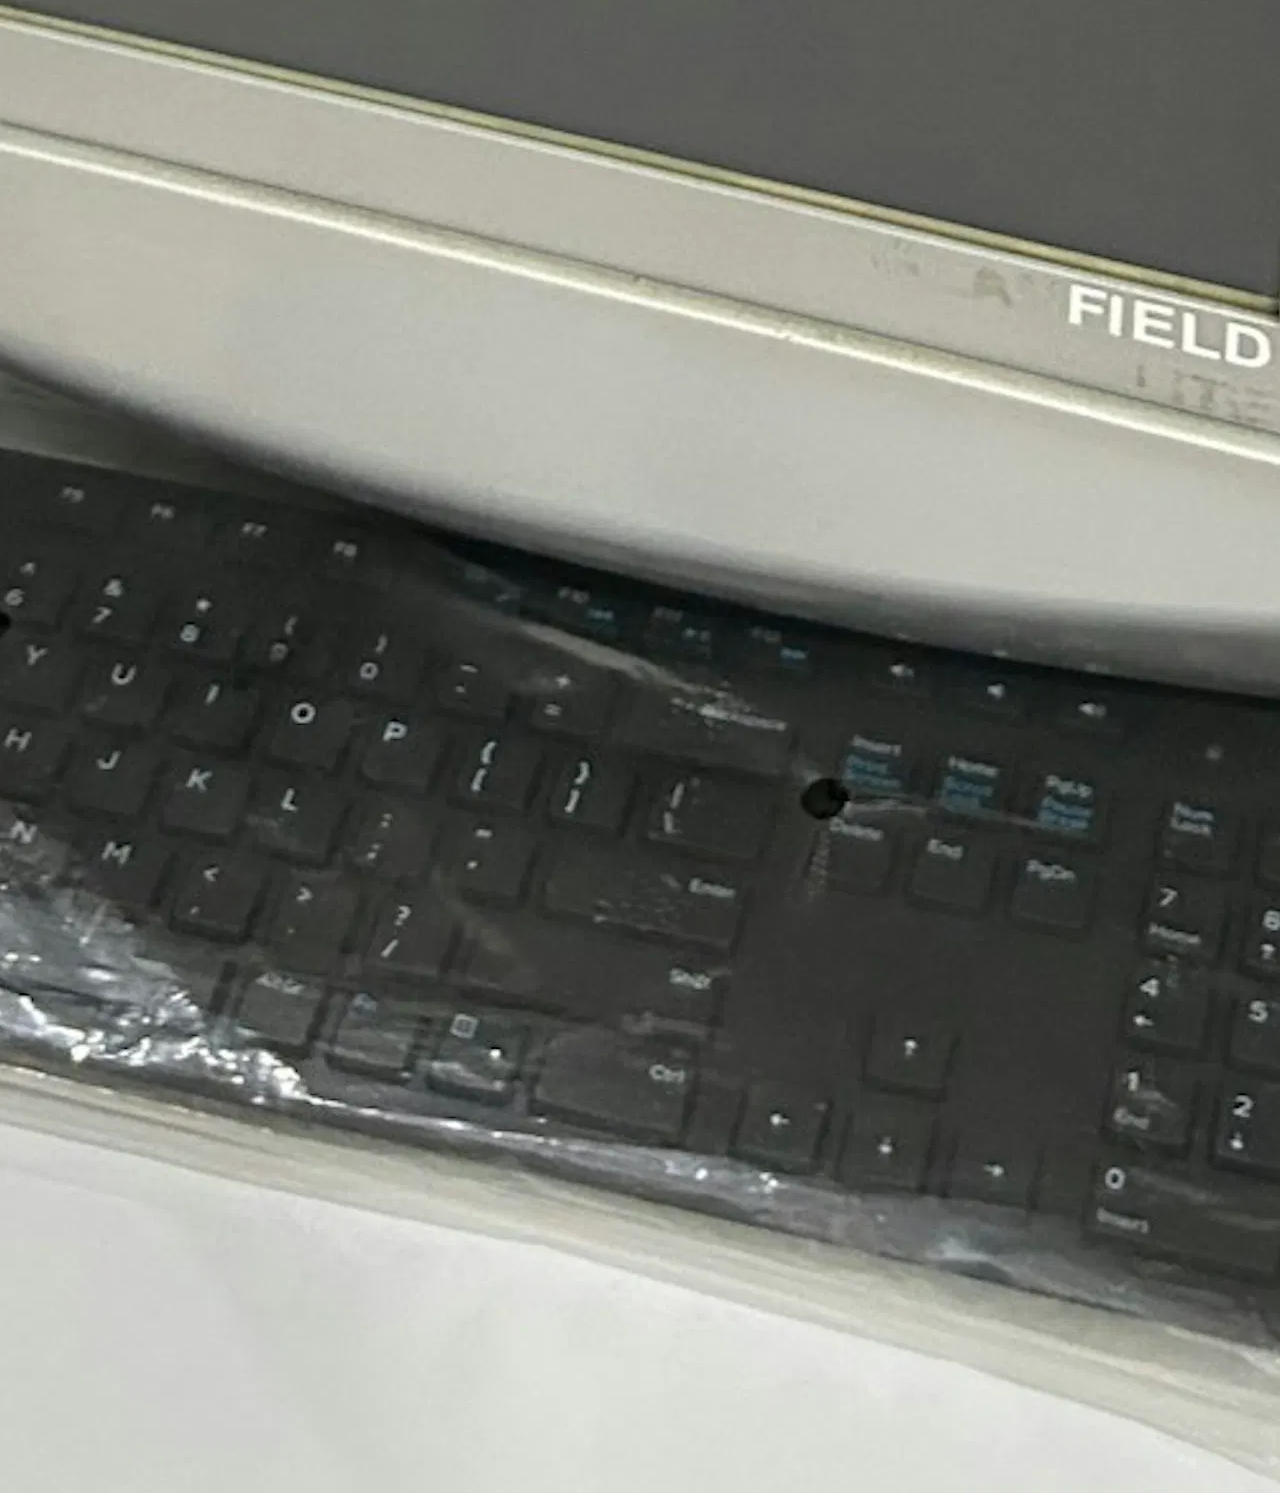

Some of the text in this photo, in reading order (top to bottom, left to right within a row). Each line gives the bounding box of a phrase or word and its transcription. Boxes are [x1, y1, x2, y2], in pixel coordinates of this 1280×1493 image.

[1068, 284, 1271, 367] FIELD
[27, 644, 47, 666] Y
[111, 664, 136, 686] U
[290, 702, 316, 724] O
[3, 728, 32, 751] H
[382, 721, 407, 742] P
[97, 751, 120, 770] J
[185, 769, 212, 791] K
[280, 788, 298, 812] L
[8, 820, 38, 844] N
[101, 841, 132, 865] M
[1159, 887, 1178, 906] 7
[1140, 978, 1159, 997] 4
[1249, 1000, 1269, 1023] 5
[1127, 1072, 1139, 1092] 1
[1233, 1095, 1254, 1118] 2
[1104, 1167, 1126, 1190] 0
